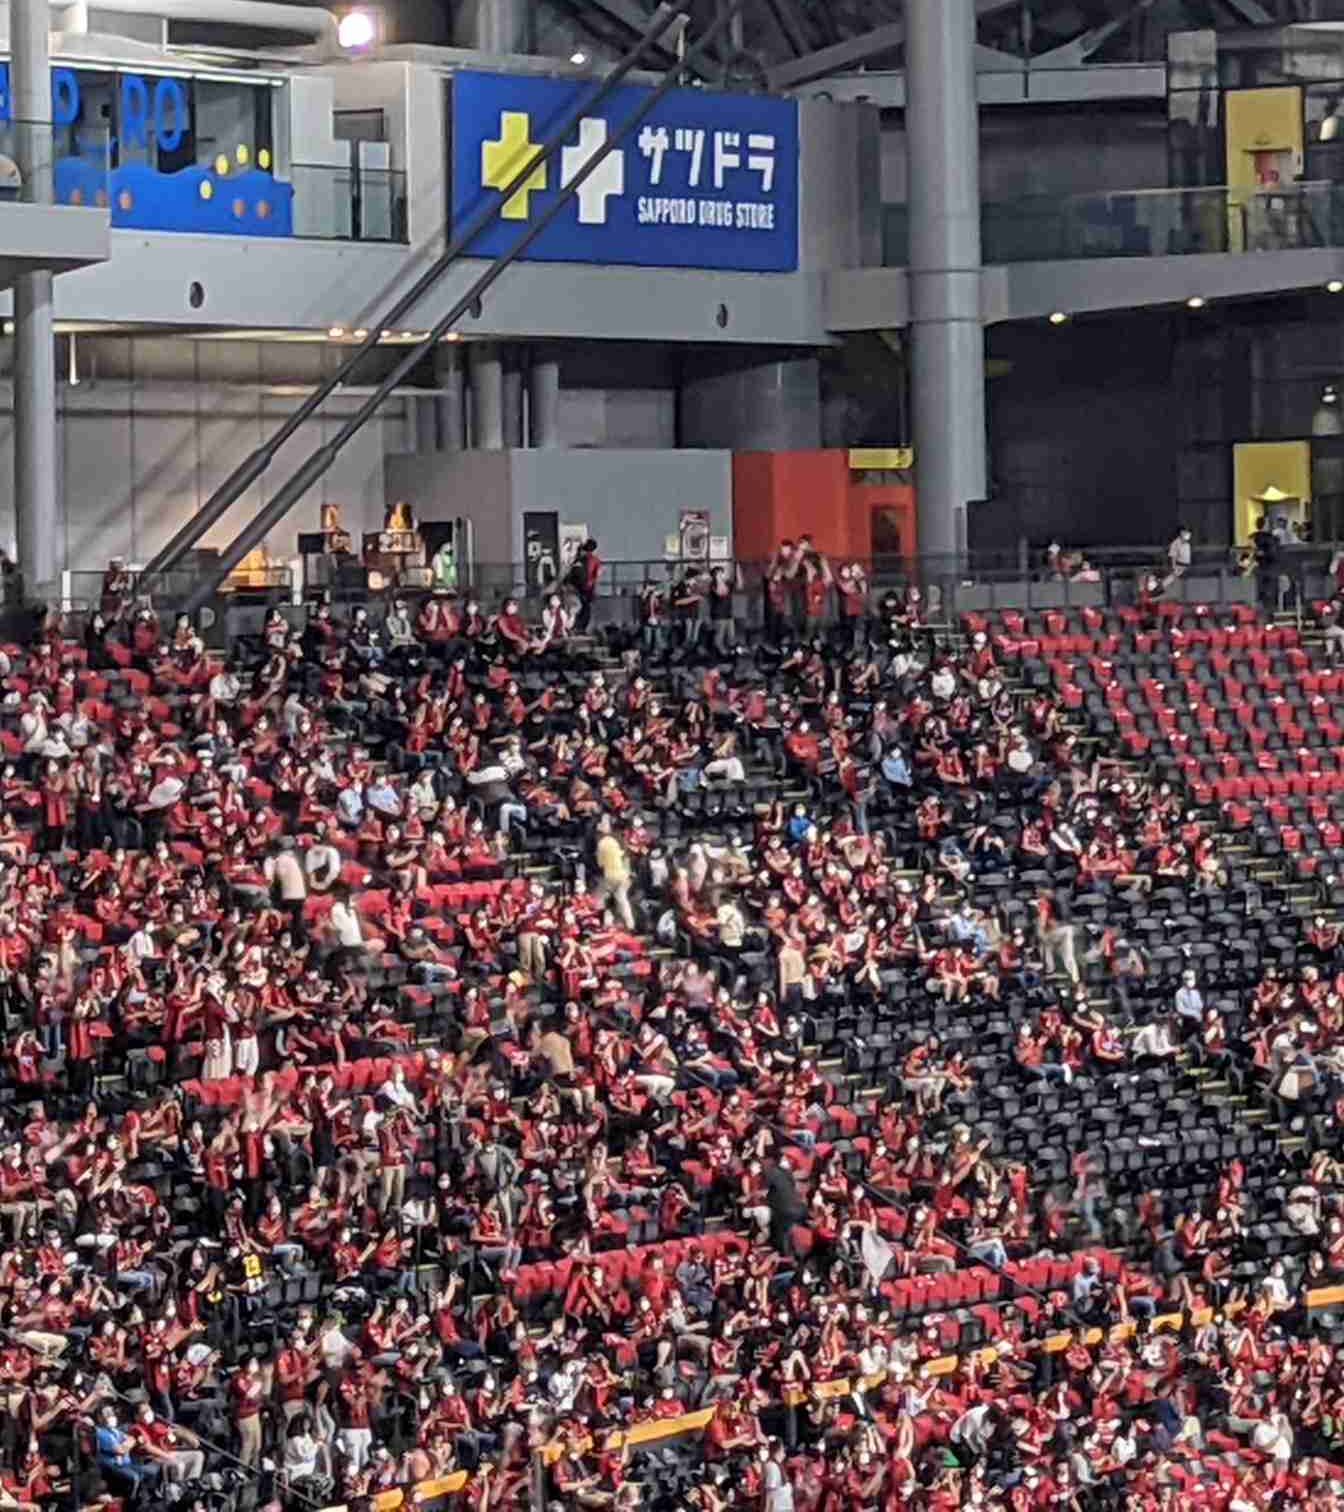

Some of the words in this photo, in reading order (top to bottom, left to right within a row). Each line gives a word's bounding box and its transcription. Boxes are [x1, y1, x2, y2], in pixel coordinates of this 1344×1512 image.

[638, 125, 776, 192] サツドラ
[638, 197, 696, 225] SAPPORO
[700, 200, 733, 227] DRUG
[736, 202, 775, 230] STORE
